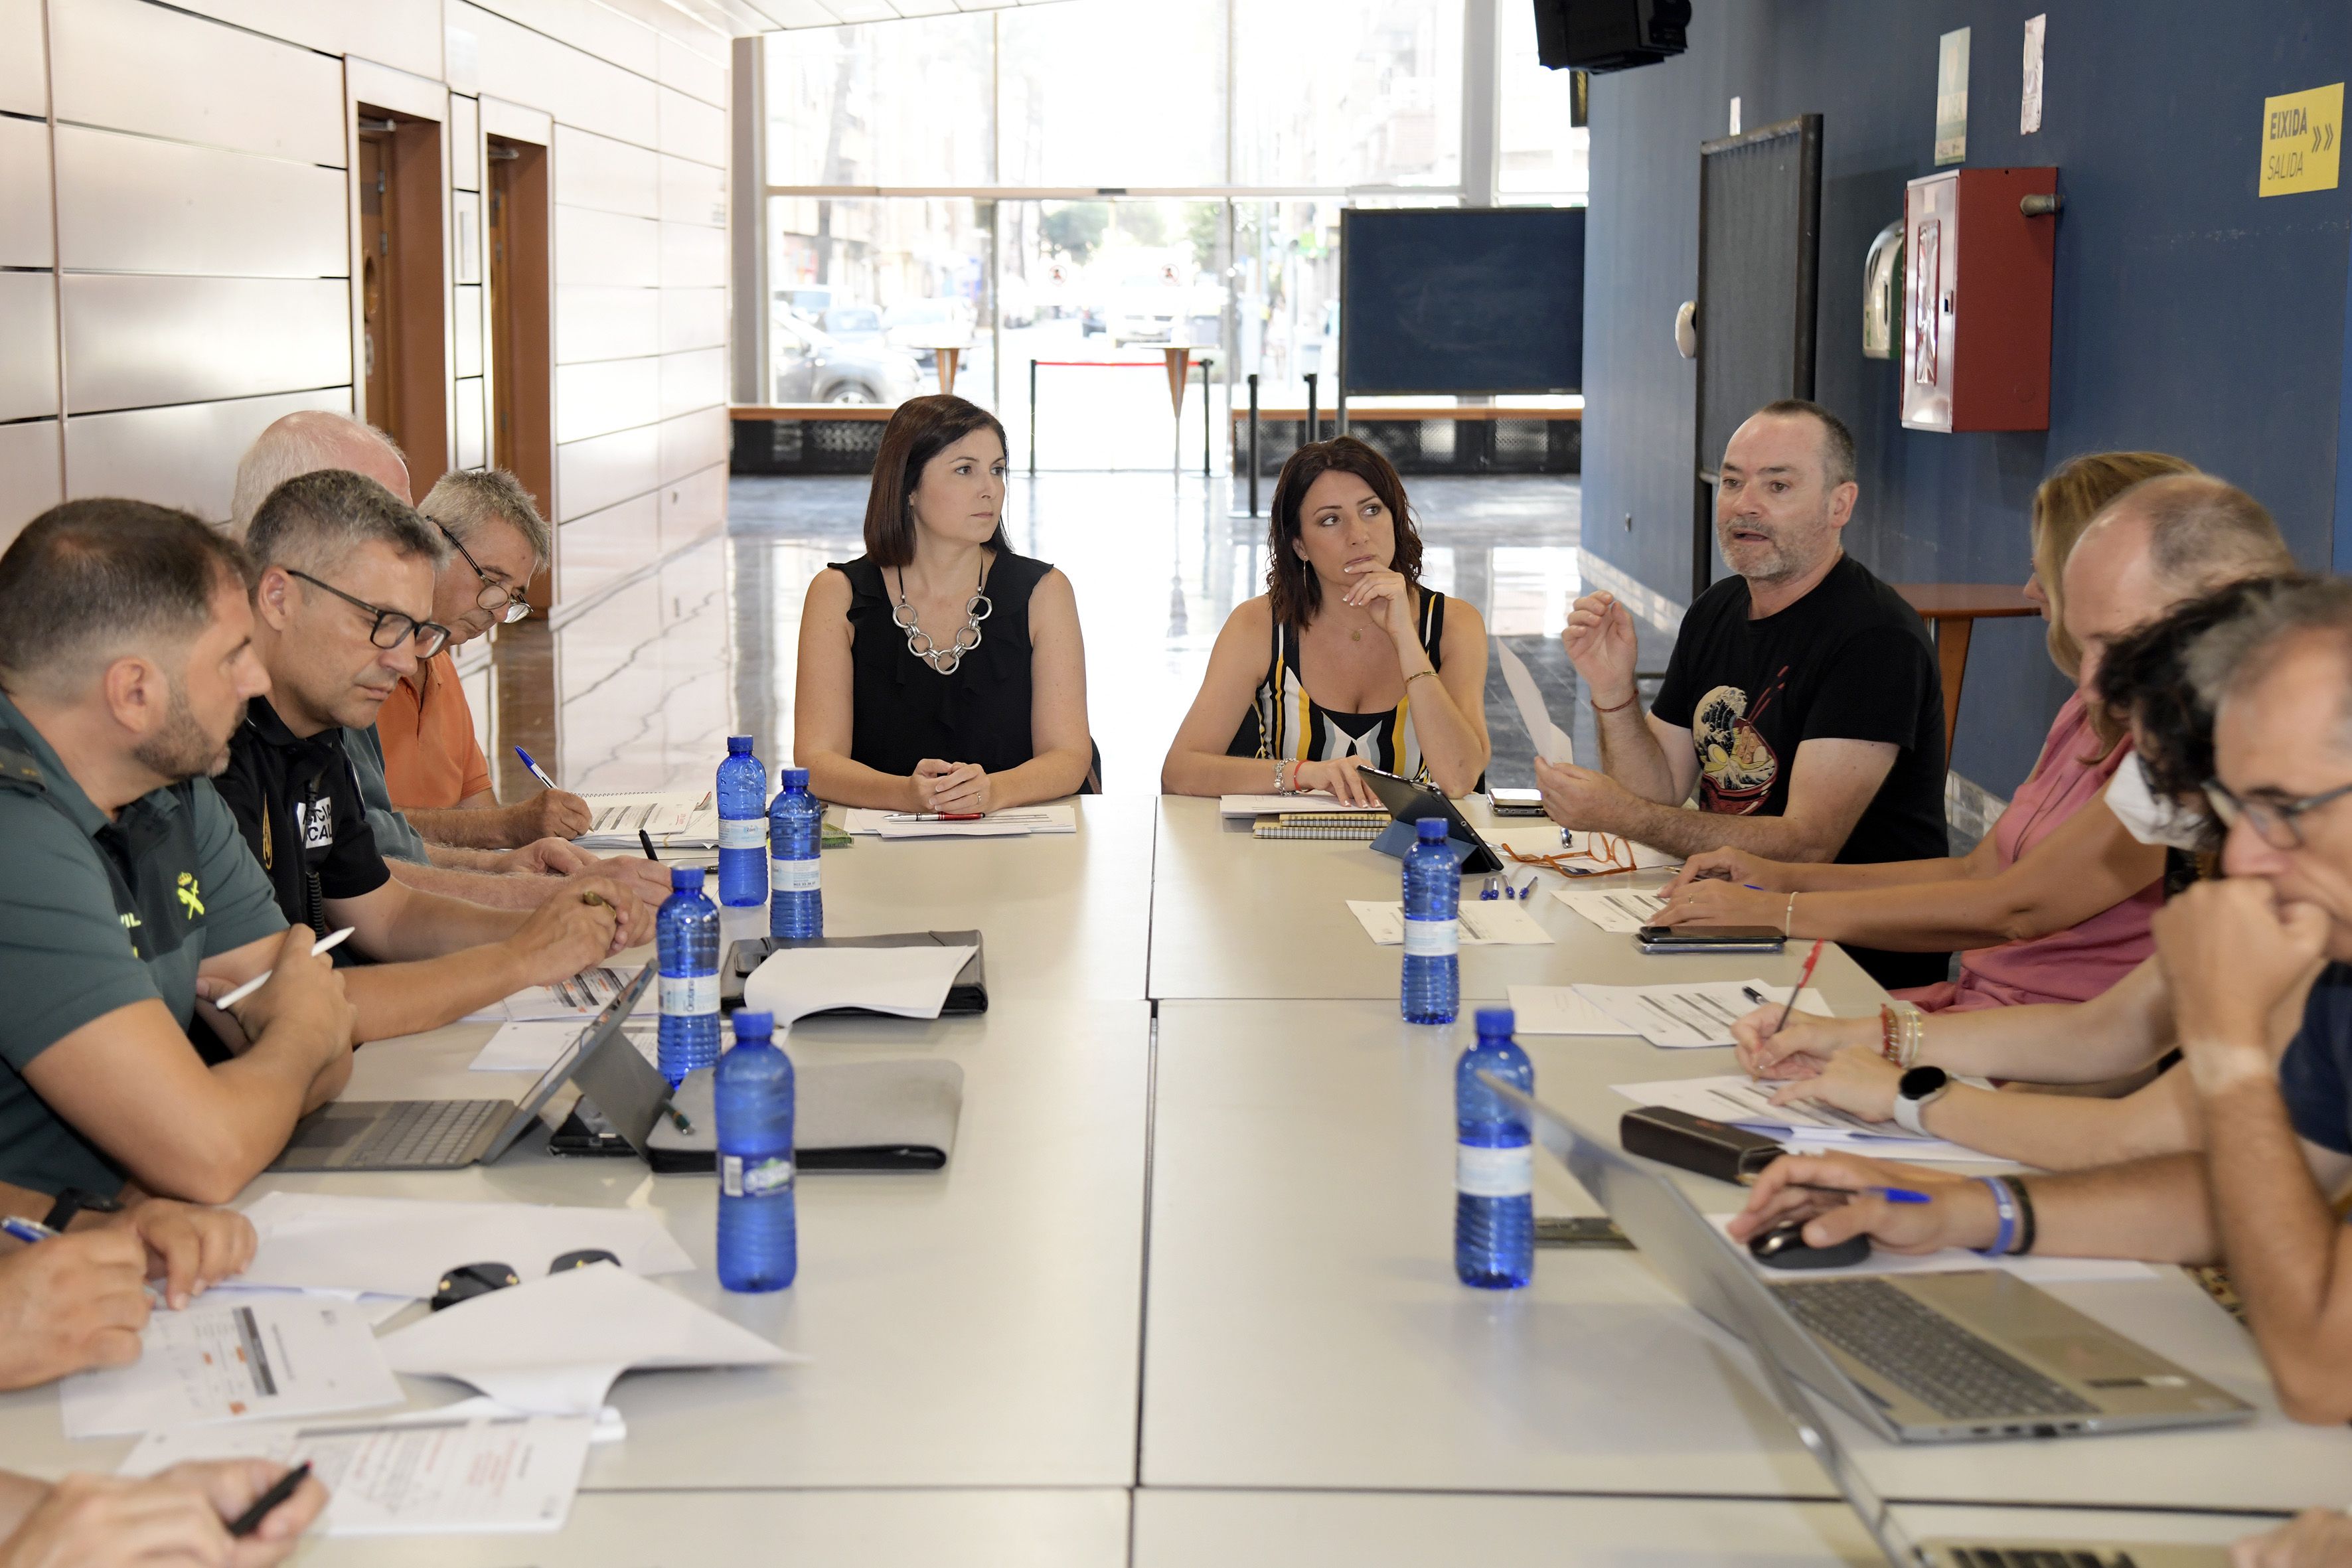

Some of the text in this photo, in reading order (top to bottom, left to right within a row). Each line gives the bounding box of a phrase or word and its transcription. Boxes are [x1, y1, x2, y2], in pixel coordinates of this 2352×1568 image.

[2270, 107, 2308, 140] EIXIDA
[2267, 151, 2304, 180] SALIDA
[307, 824, 333, 842] CAL
